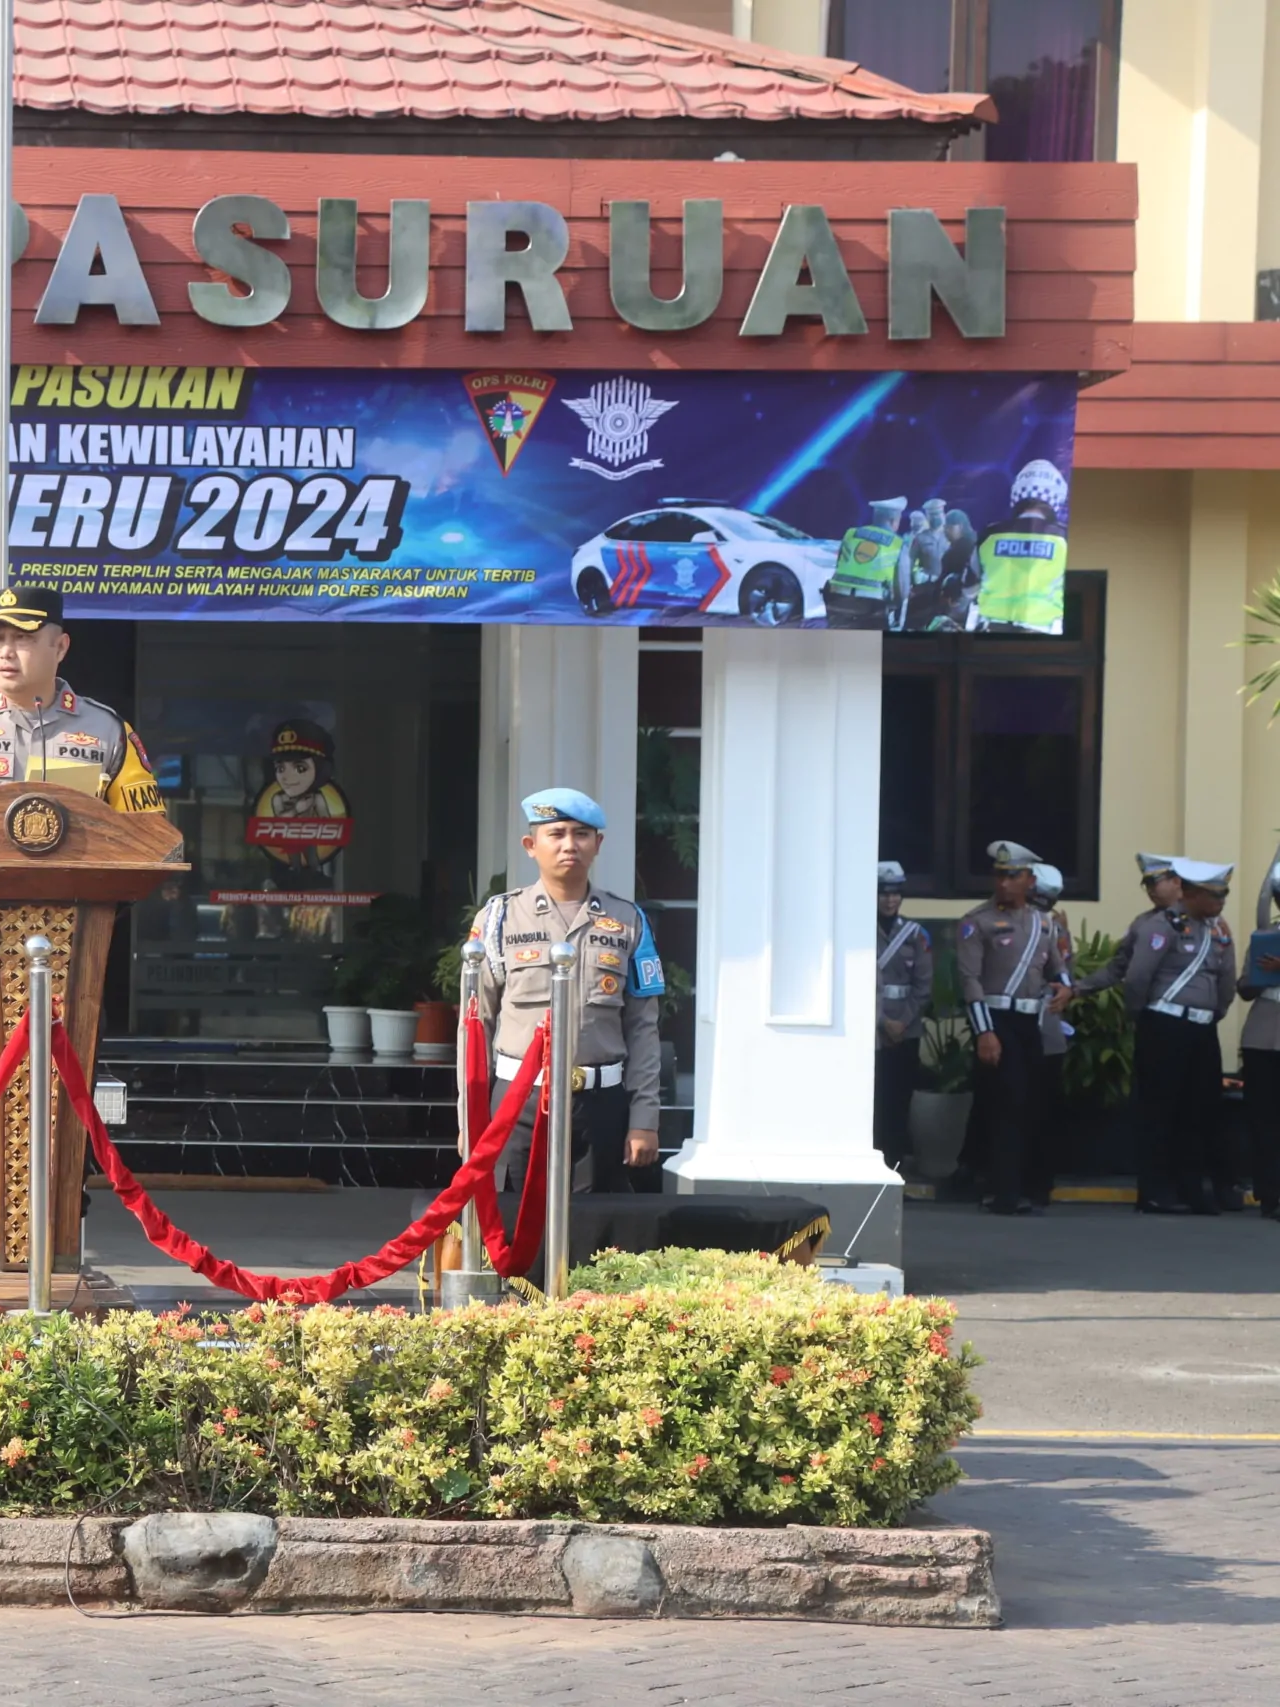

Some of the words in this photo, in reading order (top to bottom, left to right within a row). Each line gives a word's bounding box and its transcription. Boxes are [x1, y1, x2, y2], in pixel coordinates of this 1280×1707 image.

[11, 364, 246, 410] PASUKAN
[472, 375, 500, 390] OPS
[504, 374, 548, 391] POLRI
[58, 423, 355, 469] KEWILAYAHAN
[177, 476, 400, 552] 2024
[996, 540, 1054, 558] POLISI
[20, 564, 97, 577] PRESIDEN
[103, 564, 171, 578] TERPILIH
[175, 565, 223, 579] SERTA
[227, 566, 313, 580] MENGAJAK
[317, 567, 422, 581] MASYARAKAT
[425, 568, 478, 582] UNTUK
[484, 569, 536, 582] TERTIB
[62, 581, 95, 594] DAN
[98, 582, 164, 595] NYAMAN
[167, 583, 182, 595] DI
[187, 583, 255, 596] WILAYAH
[258, 583, 315, 597] HUKUM
[317, 584, 380, 597] POLRES
[383, 585, 469, 598] PASURUAN
[59, 746, 105, 763] POLRI
[255, 822, 343, 840] PRESISI
[589, 934, 629, 950] POLRI
